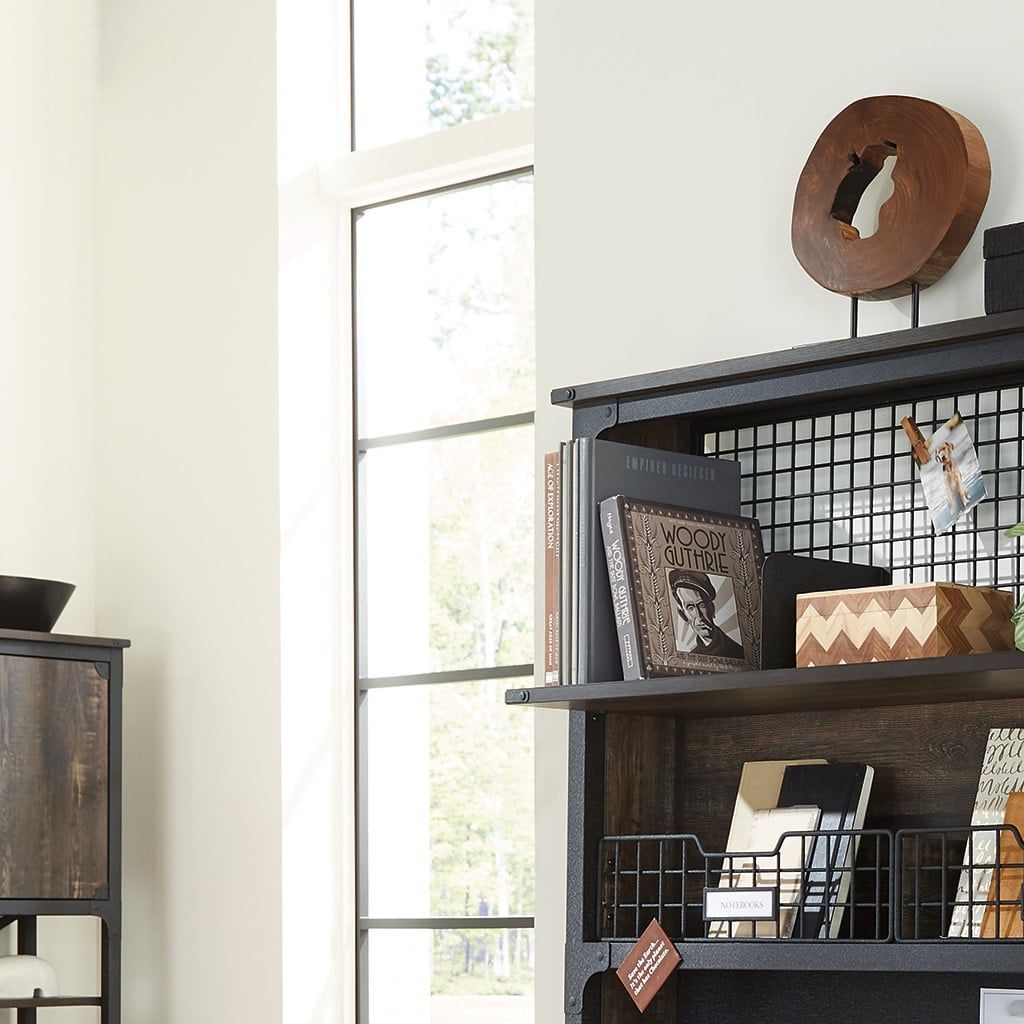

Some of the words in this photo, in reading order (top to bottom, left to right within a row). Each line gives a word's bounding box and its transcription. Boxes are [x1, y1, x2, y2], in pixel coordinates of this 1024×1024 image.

[626, 456, 667, 475] EMPIRES
[547, 480, 554, 491] OF
[660, 522, 726, 552] WOODY
[664, 545, 729, 574] GUTHRIE
[611, 539, 625, 581] WOODY
[618, 585, 632, 625] GUTHRIE
[720, 901, 764, 909] NOTEBOOKS
[627, 966, 638, 980] Save
[637, 957, 645, 968] the
[630, 978, 638, 989] It's
[636, 969, 644, 980] the
[644, 959, 653, 971] only
[652, 941, 665, 961] planet
[633, 983, 644, 996] that
[641, 973, 650, 985] has
